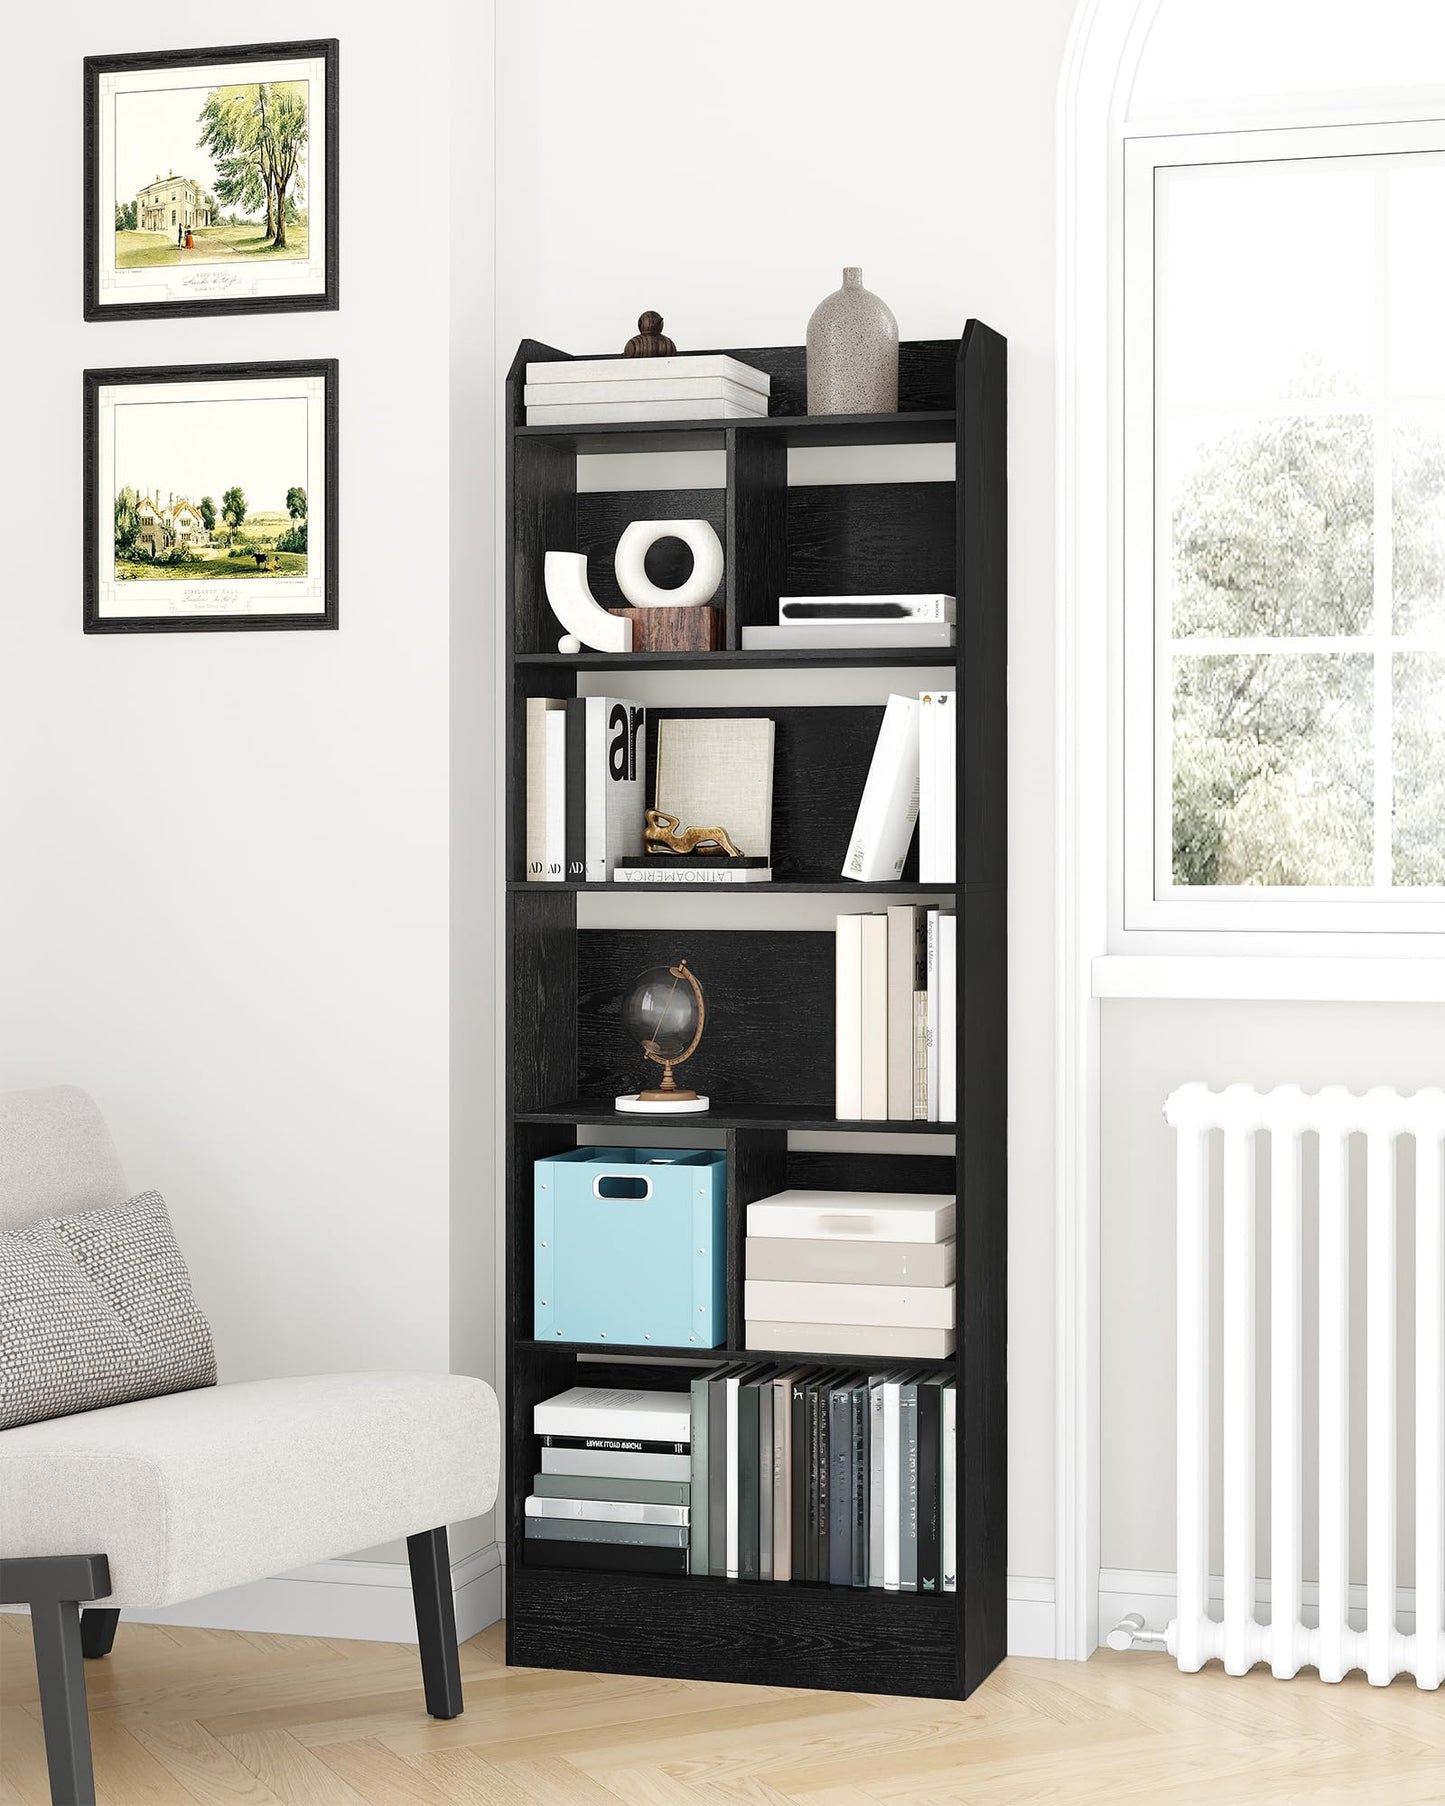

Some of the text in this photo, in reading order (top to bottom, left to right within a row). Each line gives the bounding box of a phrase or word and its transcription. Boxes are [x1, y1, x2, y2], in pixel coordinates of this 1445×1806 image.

[609, 703, 644, 782] ar
[528, 861, 543, 874] AD
[547, 863, 561, 874] AD
[568, 861, 584, 874] AD
[624, 870, 733, 882] LATINOAMERICA
